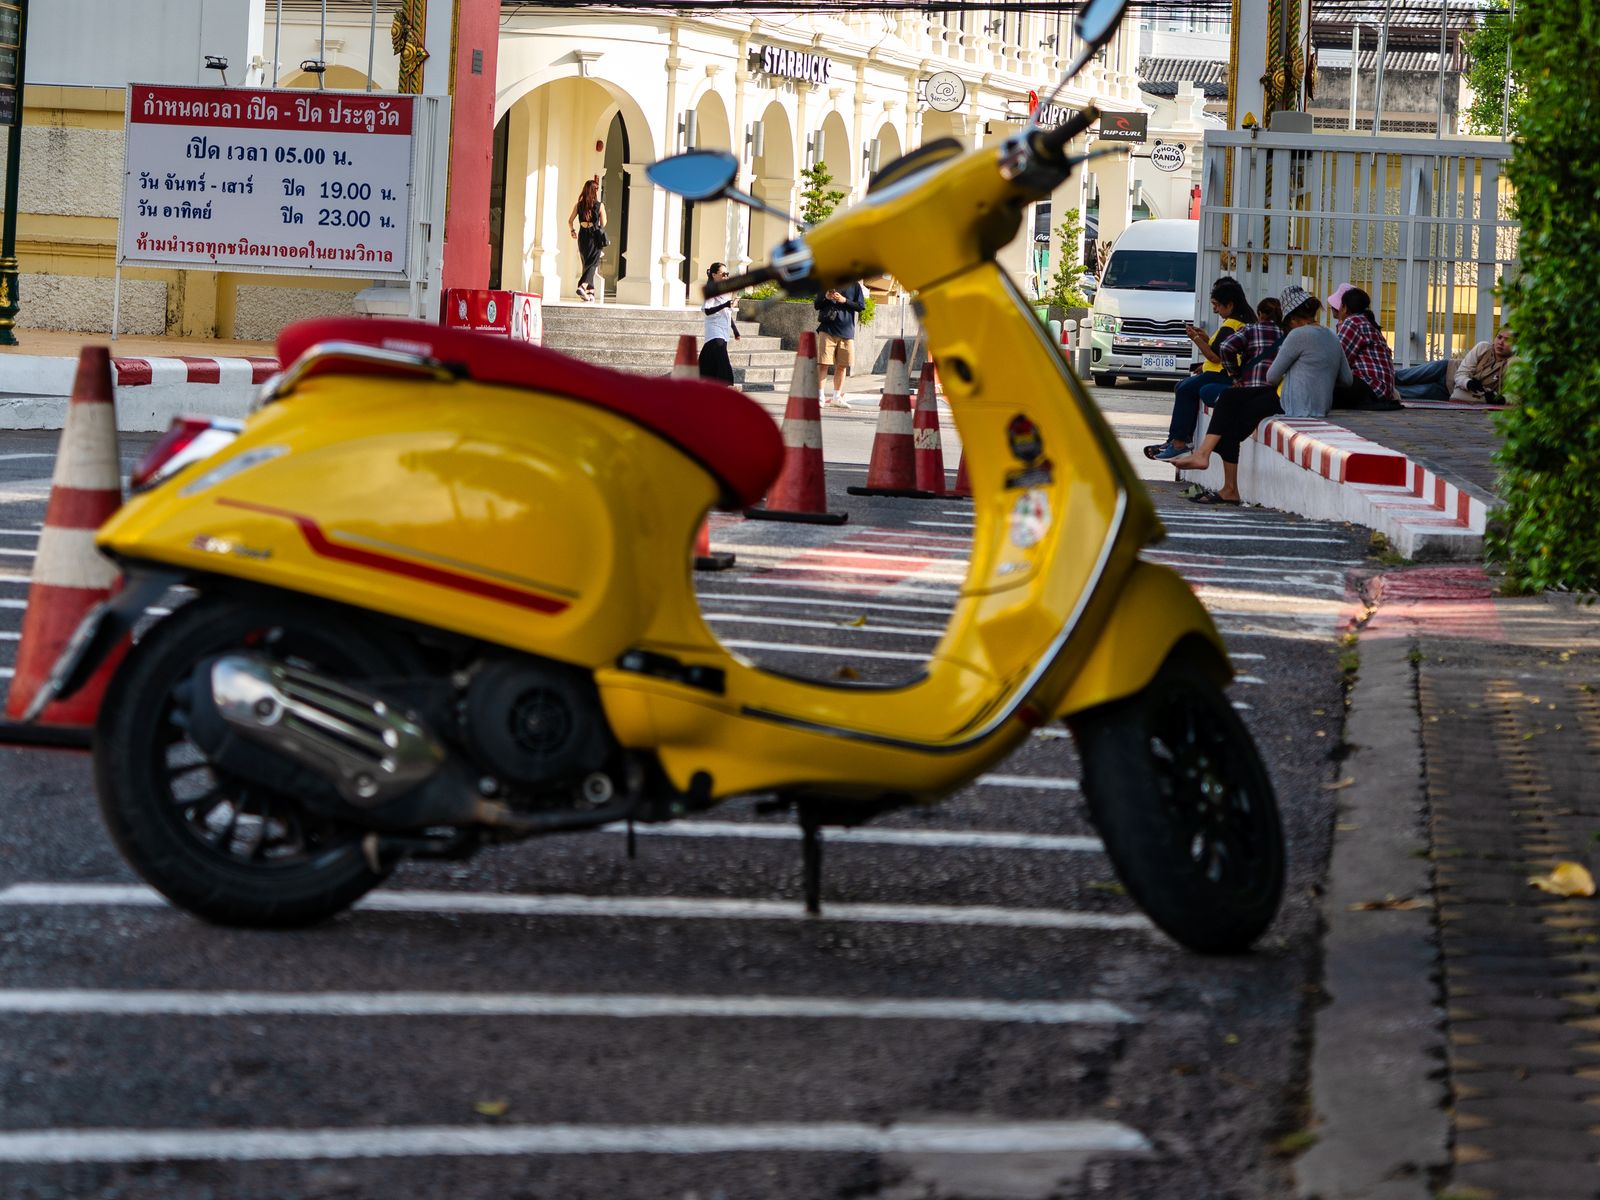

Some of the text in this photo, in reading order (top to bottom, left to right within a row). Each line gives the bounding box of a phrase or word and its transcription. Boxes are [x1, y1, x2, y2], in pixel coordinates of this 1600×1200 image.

[762, 45, 833, 84] STARBUCKS
[143, 92, 241, 119] กำหนดเวลา
[246, 96, 278, 120] เปิด
[295, 98, 322, 123] ปิด
[329, 99, 400, 132] ประตูวัด
[186, 136, 353, 166] เปิด เวลา 05.00 น.
[1156, 147, 1180, 155] PHOTO
[139, 171, 159, 189] วัน
[164, 172, 206, 192] จันทร์
[221, 175, 254, 194] เสาร์
[282, 178, 305, 196] ปิด
[320, 181, 371, 200] 19.00
[381, 189, 396, 201] น.
[138, 199, 395, 228] วัน อาทิตย์ ปิด 23.00 น.
[136, 231, 393, 262] ห้ามนำรถทุกชนิดมาจอดในยามวิกาล
[1143, 357, 1174, 367] 36-0189
